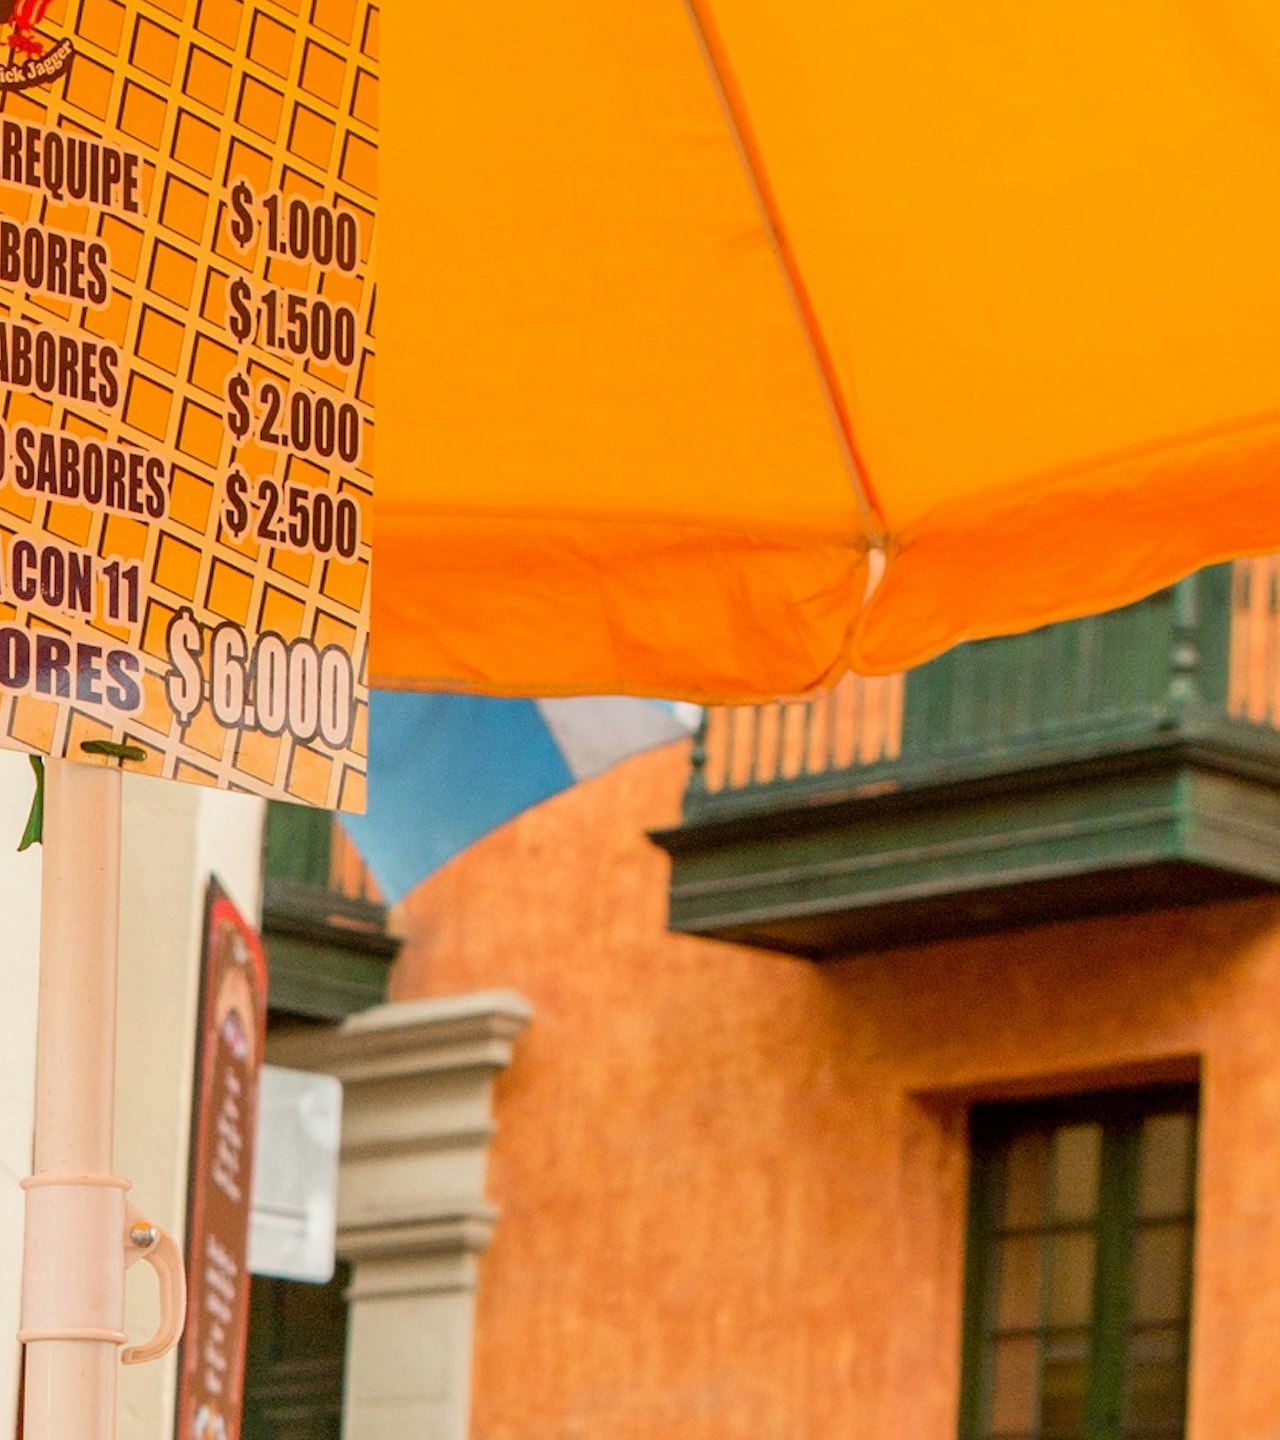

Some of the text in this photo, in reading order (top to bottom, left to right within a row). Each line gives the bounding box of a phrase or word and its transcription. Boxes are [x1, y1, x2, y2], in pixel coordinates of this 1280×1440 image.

[27, 40, 72, 79] Jagger
[15, 427, 166, 518] SABORES
[12, 540, 91, 613] CON
[102, 563, 138, 623] 11
